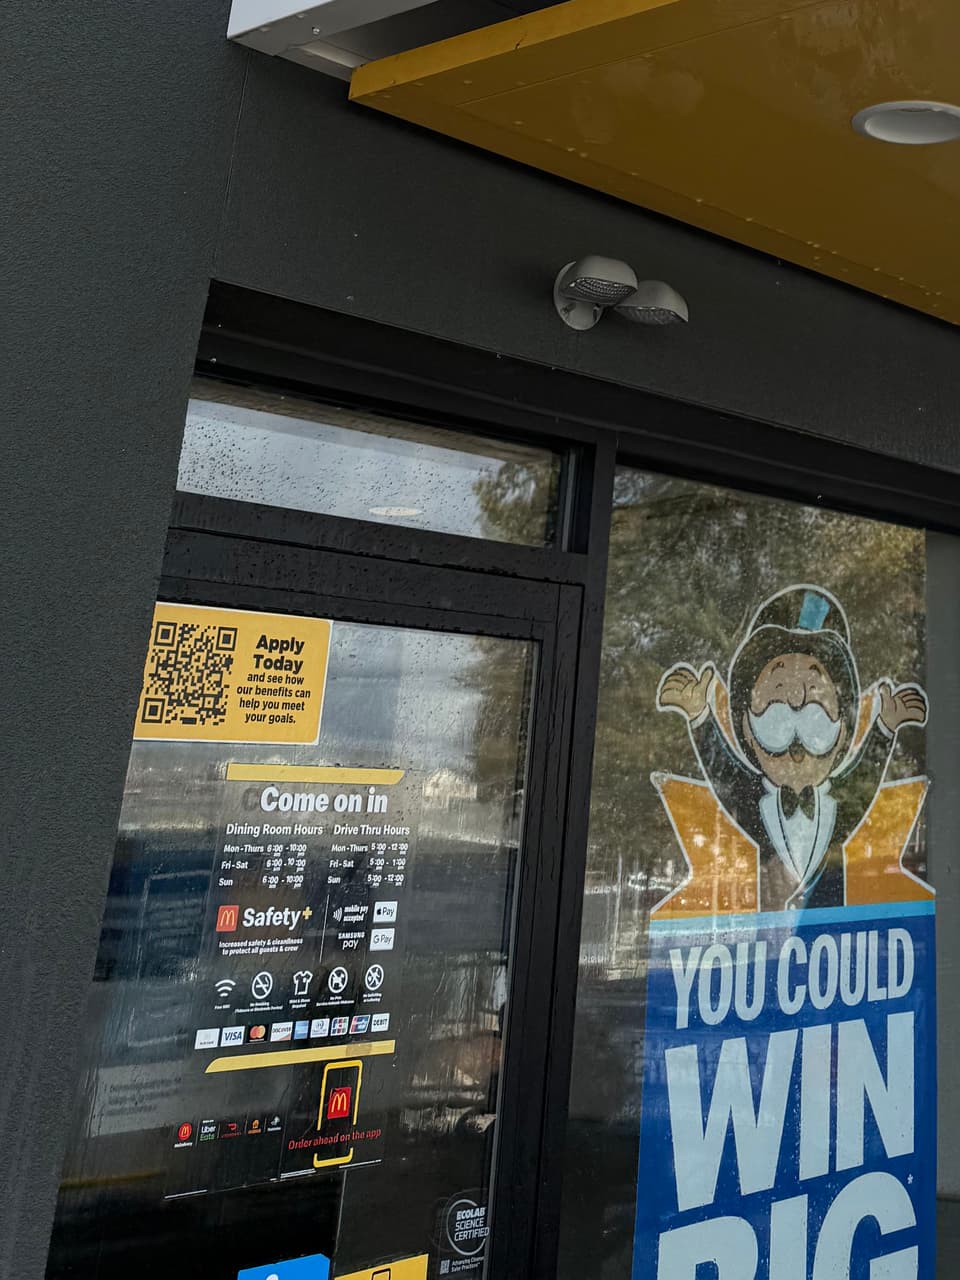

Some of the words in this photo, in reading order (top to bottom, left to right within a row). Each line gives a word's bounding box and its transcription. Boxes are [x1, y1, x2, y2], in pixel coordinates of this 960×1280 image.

[256, 634, 305, 655] Apply
[253, 654, 304, 675] Today
[247, 672, 266, 683] and
[266, 673, 283, 684] see
[285, 674, 304, 685] how
[236, 685, 253, 695] our
[255, 685, 293, 697] benefits
[294, 689, 311, 698] can
[239, 697, 260, 711] help
[262, 701, 280, 711] you
[281, 701, 305, 711] meet
[245, 712, 267, 724] your
[268, 713, 296, 725] goals.
[260, 786, 330, 813] Come
[333, 793, 363, 813] on
[366, 786, 389, 814] in
[226, 822, 261, 838] Dining
[262, 823, 292, 835] Room
[293, 823, 324, 836] Hours
[333, 824, 359, 836] Drive
[360, 824, 382, 836] Thru
[383, 824, 411, 836] Hours
[218, 877, 234, 887] Sun
[327, 875, 342, 885] Sun
[338, 931, 365, 940] SAMSUNG
[219, 940, 248, 949] Increased
[248, 939, 266, 948] safety
[342, 939, 359, 951] pay
[222, 948, 229, 956] to
[228, 947, 252, 957] protect
[251, 946, 259, 954] all
[669, 941, 768, 1030] YOU
[777, 927, 915, 1015] COULD
[224, 1031, 242, 1041] VISA
[664, 1011, 915, 1212] WIN
[288, 1138, 313, 1151] Order
[313, 1132, 339, 1147] ahead
[340, 1133, 351, 1142] on
[352, 1130, 365, 1141] the
[366, 1128, 382, 1141] app
[456, 1207, 486, 1221] ECOLAB
[454, 1217, 485, 1231] SCIENCE
[454, 1227, 490, 1242] CERTIFIED
